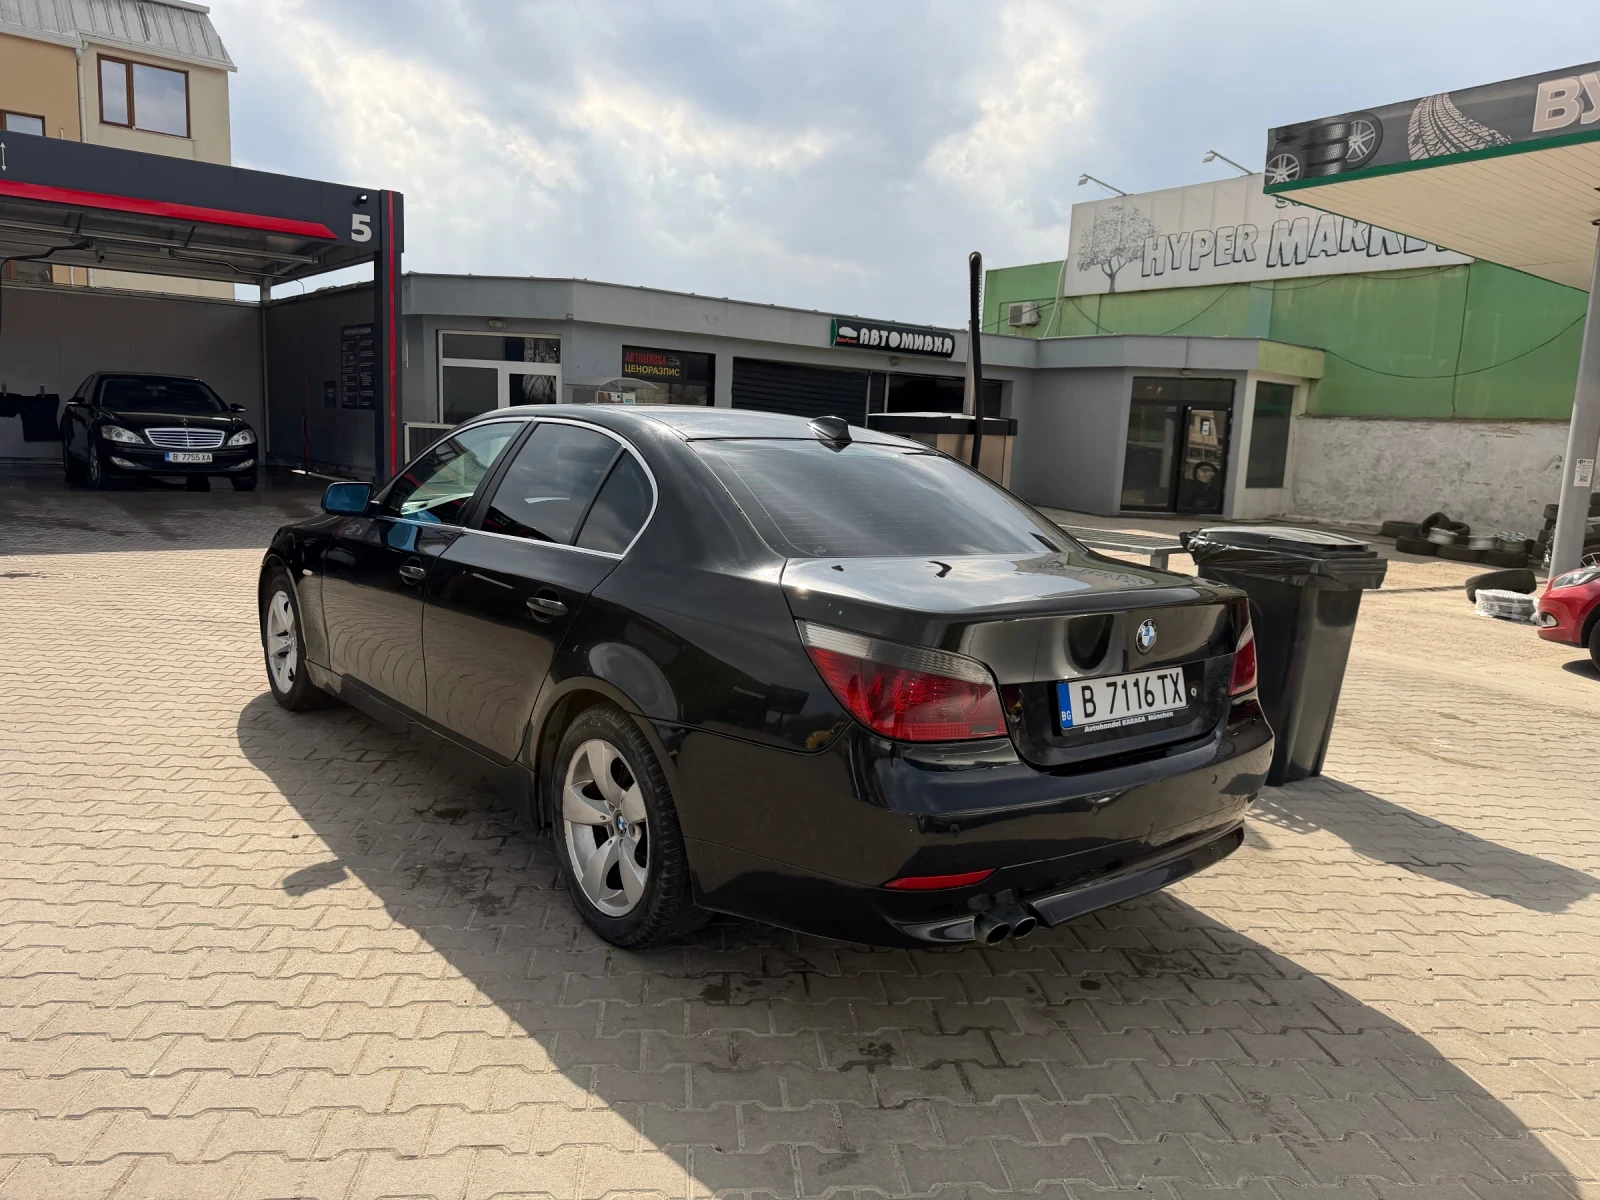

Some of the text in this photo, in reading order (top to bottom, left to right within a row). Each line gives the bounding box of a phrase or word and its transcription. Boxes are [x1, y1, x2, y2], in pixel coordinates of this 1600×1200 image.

[351, 213, 372, 243] 5
[1141, 223, 1259, 277] HYPER
[859, 327, 953, 354] АВТОМИВКА
[624, 364, 681, 377] ЦЕНОРАЗПИС
[172, 453, 179, 461] B
[181, 453, 201, 461] 7755
[1081, 672, 1183, 719] B 7116 TX
[1061, 710, 1072, 721] BG
[1084, 721, 1121, 732] Autohandel
